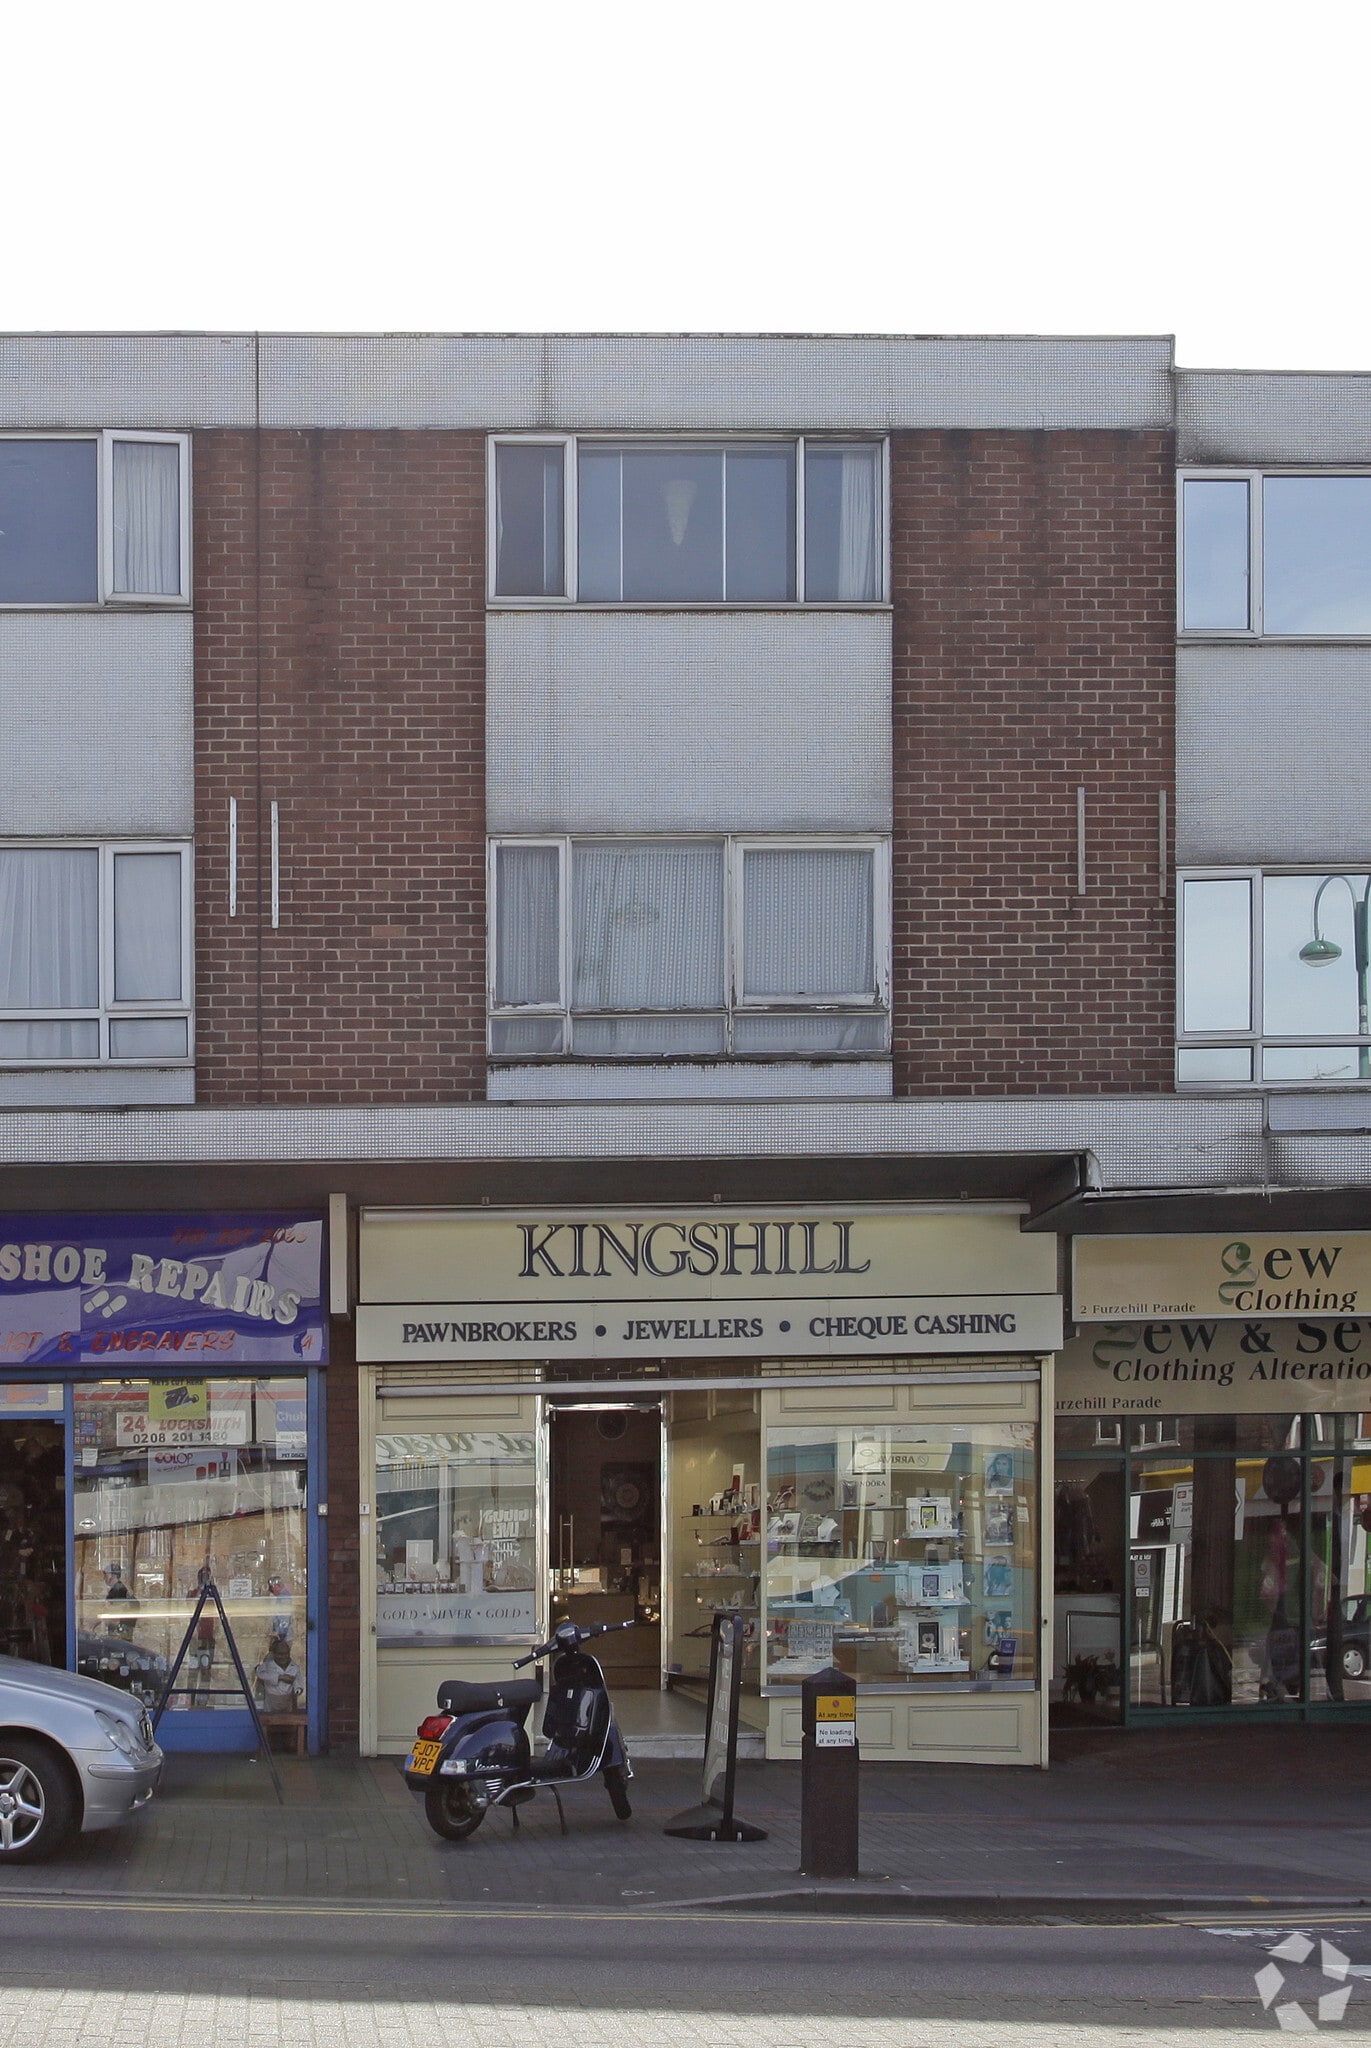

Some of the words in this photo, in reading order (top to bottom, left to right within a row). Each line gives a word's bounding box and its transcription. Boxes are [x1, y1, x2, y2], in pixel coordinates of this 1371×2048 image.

[516, 1220, 871, 1277] KINGSHILL
[0, 1244, 107, 1285] SHOE
[127, 1253, 301, 1325] REPAIRS
[1080, 1305, 1087, 1314] 2
[1092, 1304, 1148, 1314] Furzehill
[1153, 1302, 1196, 1313] Parade
[1235, 1288, 1357, 1312] Clothing
[402, 1320, 577, 1344] PAWNBROKERS
[622, 1318, 763, 1341] JEWELLERS
[809, 1315, 908, 1339] CHEQUE
[914, 1313, 1016, 1335] CASHING
[91, 1330, 237, 1353] ENGRAVERS
[1240, 1323, 1275, 1353] &
[1296, 1322, 1371, 1353] Se
[1113, 1359, 1235, 1386] Clothing
[1112, 1397, 1162, 1409] Parade
[123, 1416, 146, 1433] 24
[133, 1433, 166, 1445] 0208
[172, 1432, 194, 1443] 201
[155, 1451, 194, 1465] COLOP
[382, 1608, 418, 1620] GOLD
[431, 1607, 473, 1620] SILVER
[485, 1607, 521, 1619] GOLD
[411, 1742, 441, 1758] FJ07
[413, 1756, 434, 1771] VPC
